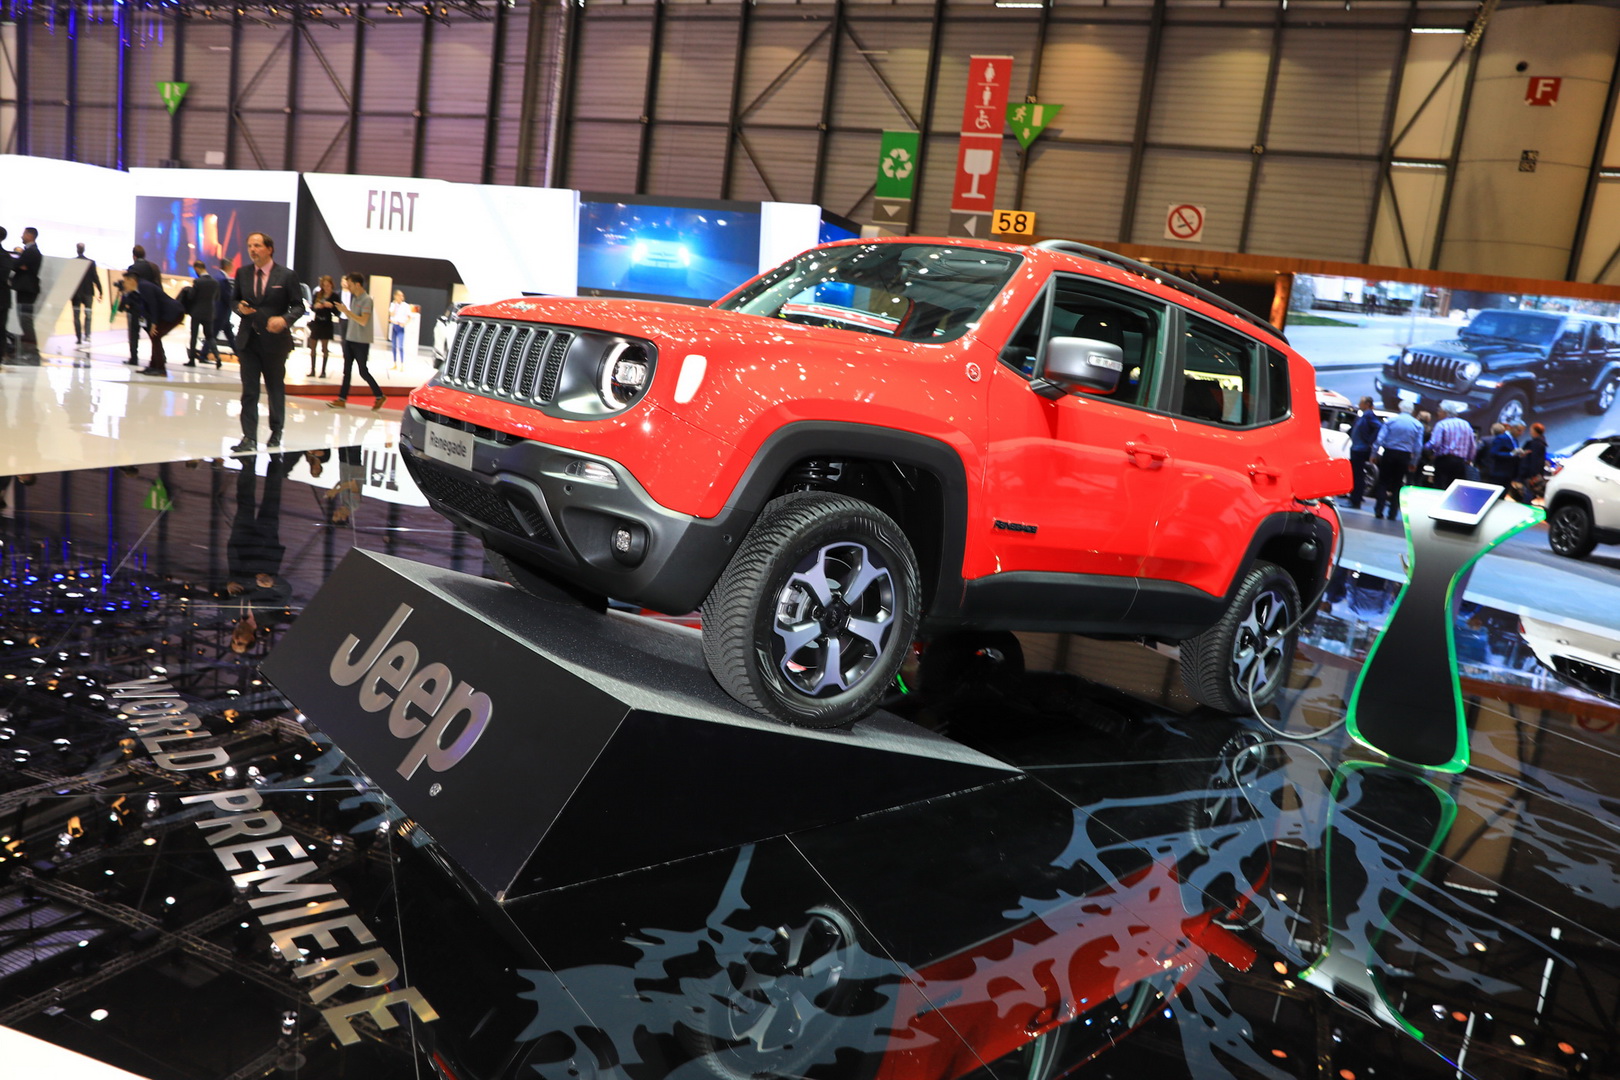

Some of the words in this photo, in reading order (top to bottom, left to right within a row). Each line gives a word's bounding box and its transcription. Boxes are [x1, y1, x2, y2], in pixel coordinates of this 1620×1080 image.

[1536, 79, 1555, 99] F
[366, 189, 419, 232] FIAT
[998, 212, 1027, 233] 58
[430, 430, 467, 458] Renegade
[106, 676, 230, 771] WORLD
[179, 787, 440, 1046] PREMIERE
